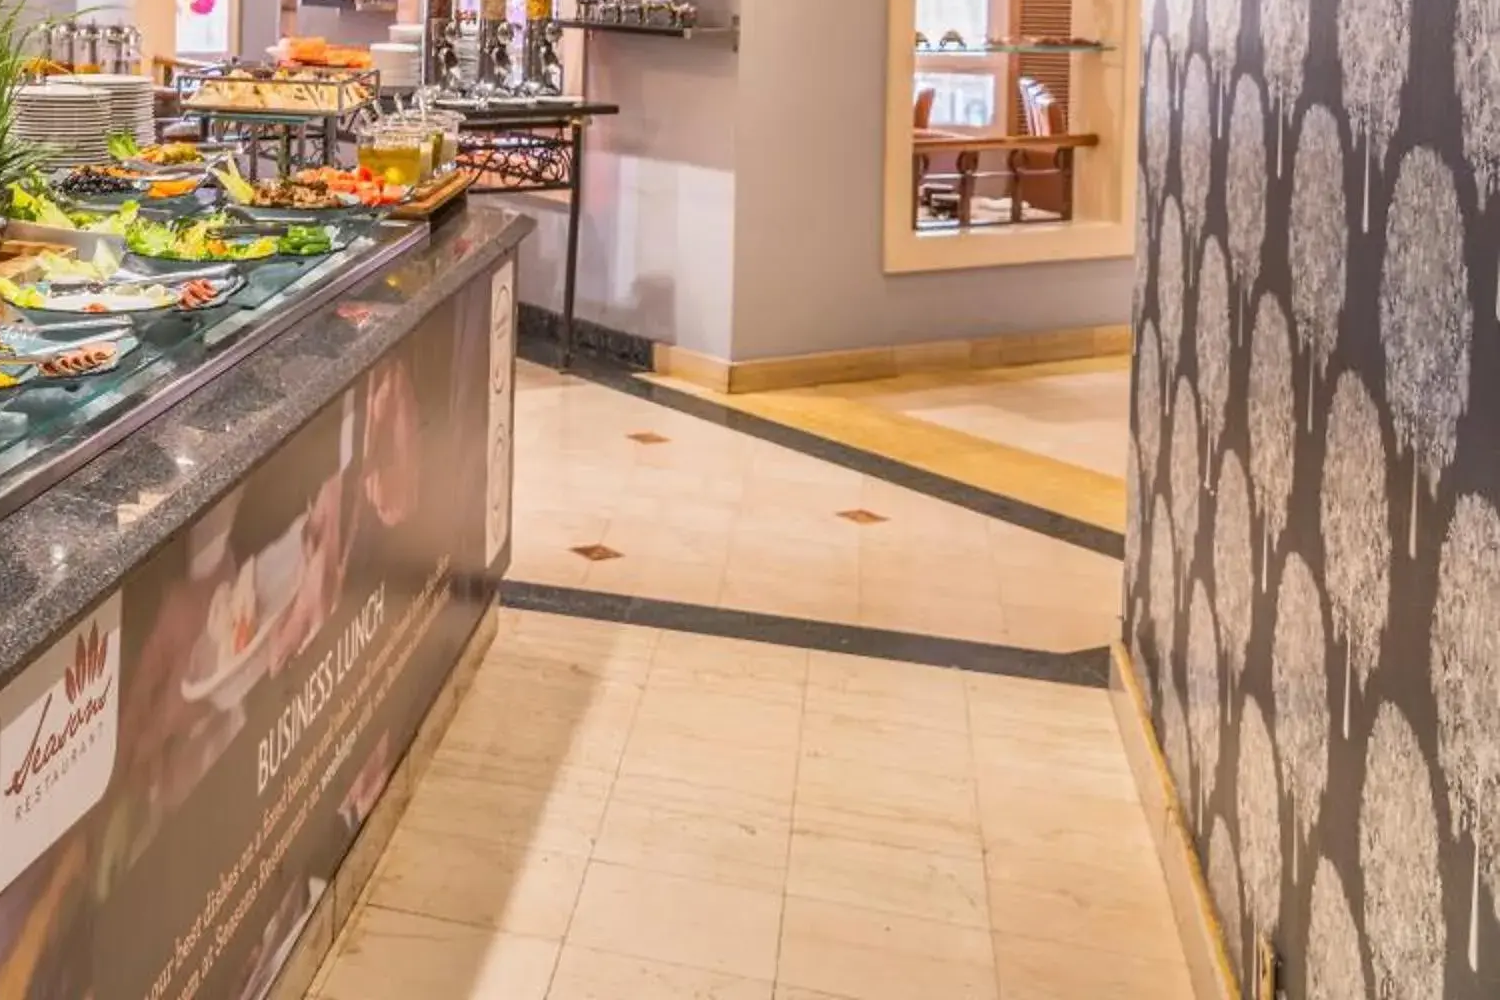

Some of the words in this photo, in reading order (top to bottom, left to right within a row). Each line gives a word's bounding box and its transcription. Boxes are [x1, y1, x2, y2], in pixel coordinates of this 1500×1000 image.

[256, 649, 334, 797] BUSINESS
[336, 579, 386, 685] LUNCH
[15, 720, 104, 823] RESTAURANT
[174, 913, 202, 973] best
[203, 861, 240, 929] dishes
[215, 877, 258, 957] Seasons
[259, 798, 308, 890] Restaurant
